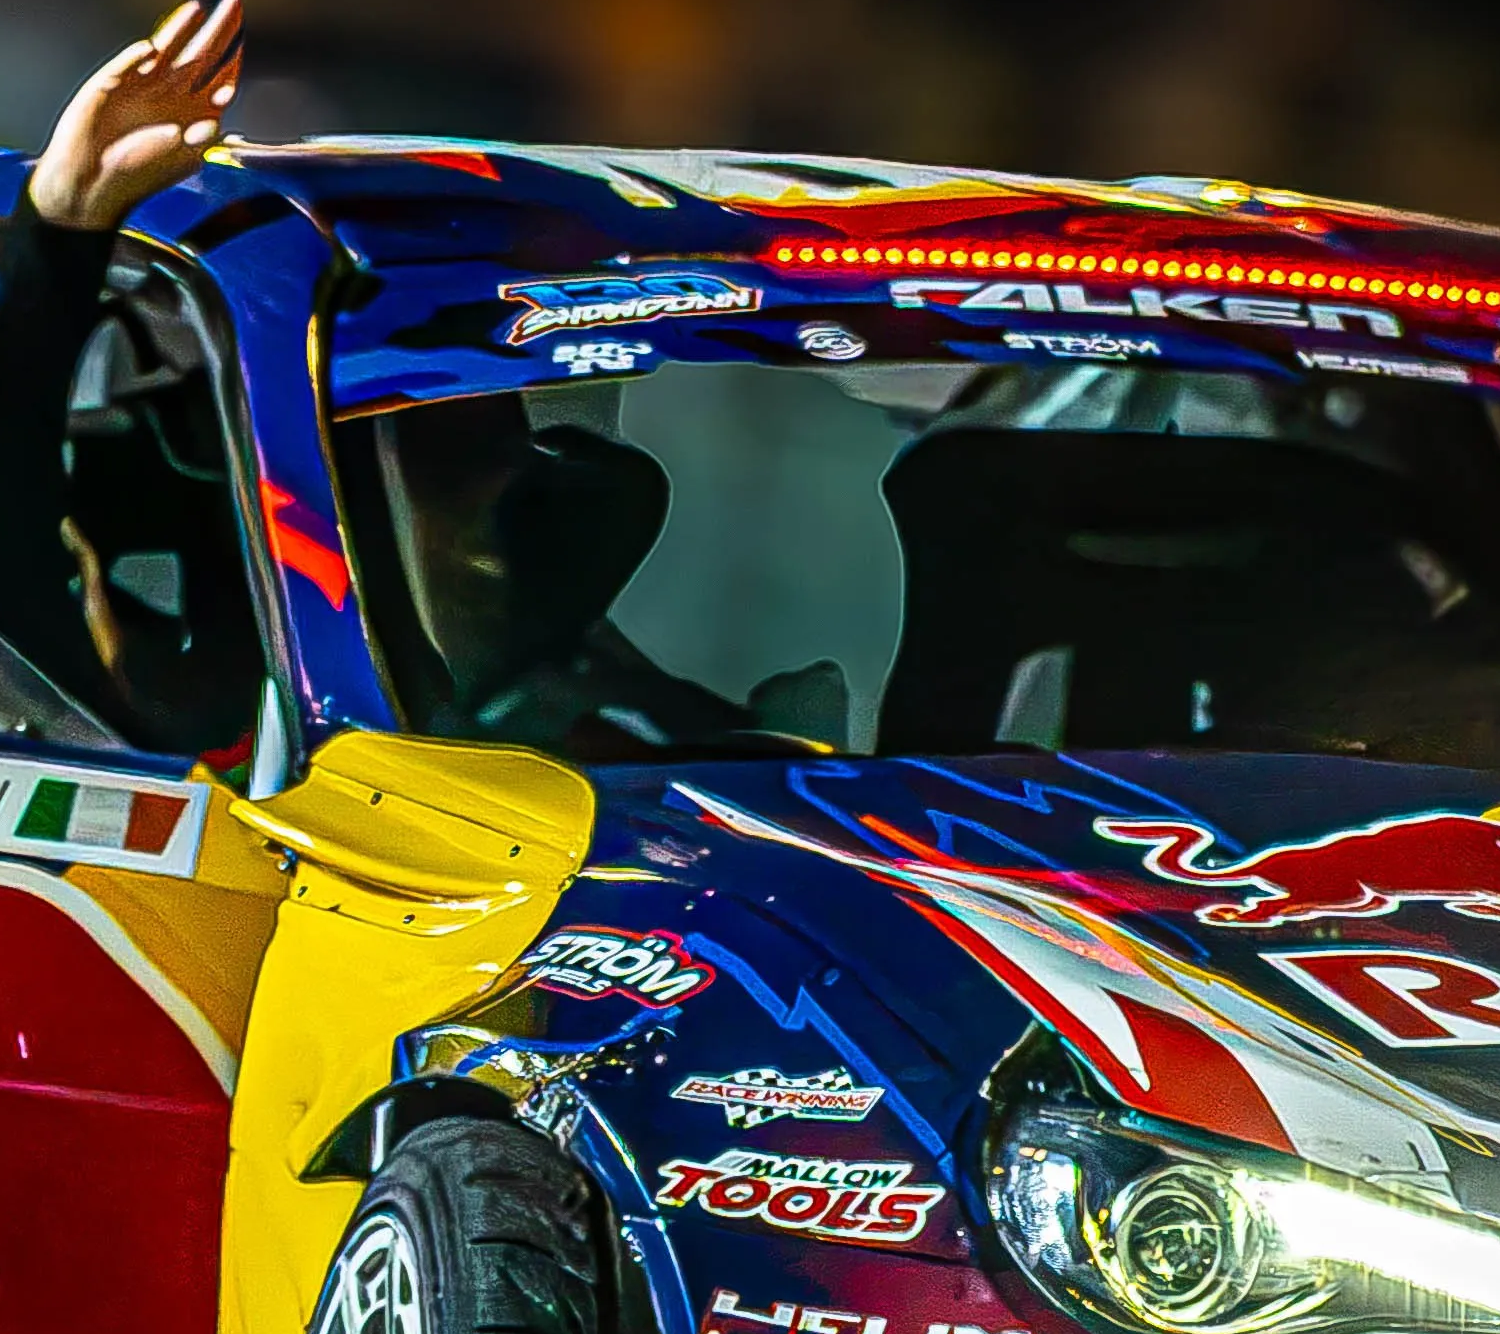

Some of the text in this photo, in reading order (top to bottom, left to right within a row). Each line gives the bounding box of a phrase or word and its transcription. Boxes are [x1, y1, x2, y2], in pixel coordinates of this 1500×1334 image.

[519, 934, 701, 1002] STRÖM
[660, 1162, 942, 1236] TOOLS
[741, 1157, 901, 1189] MALLOW
